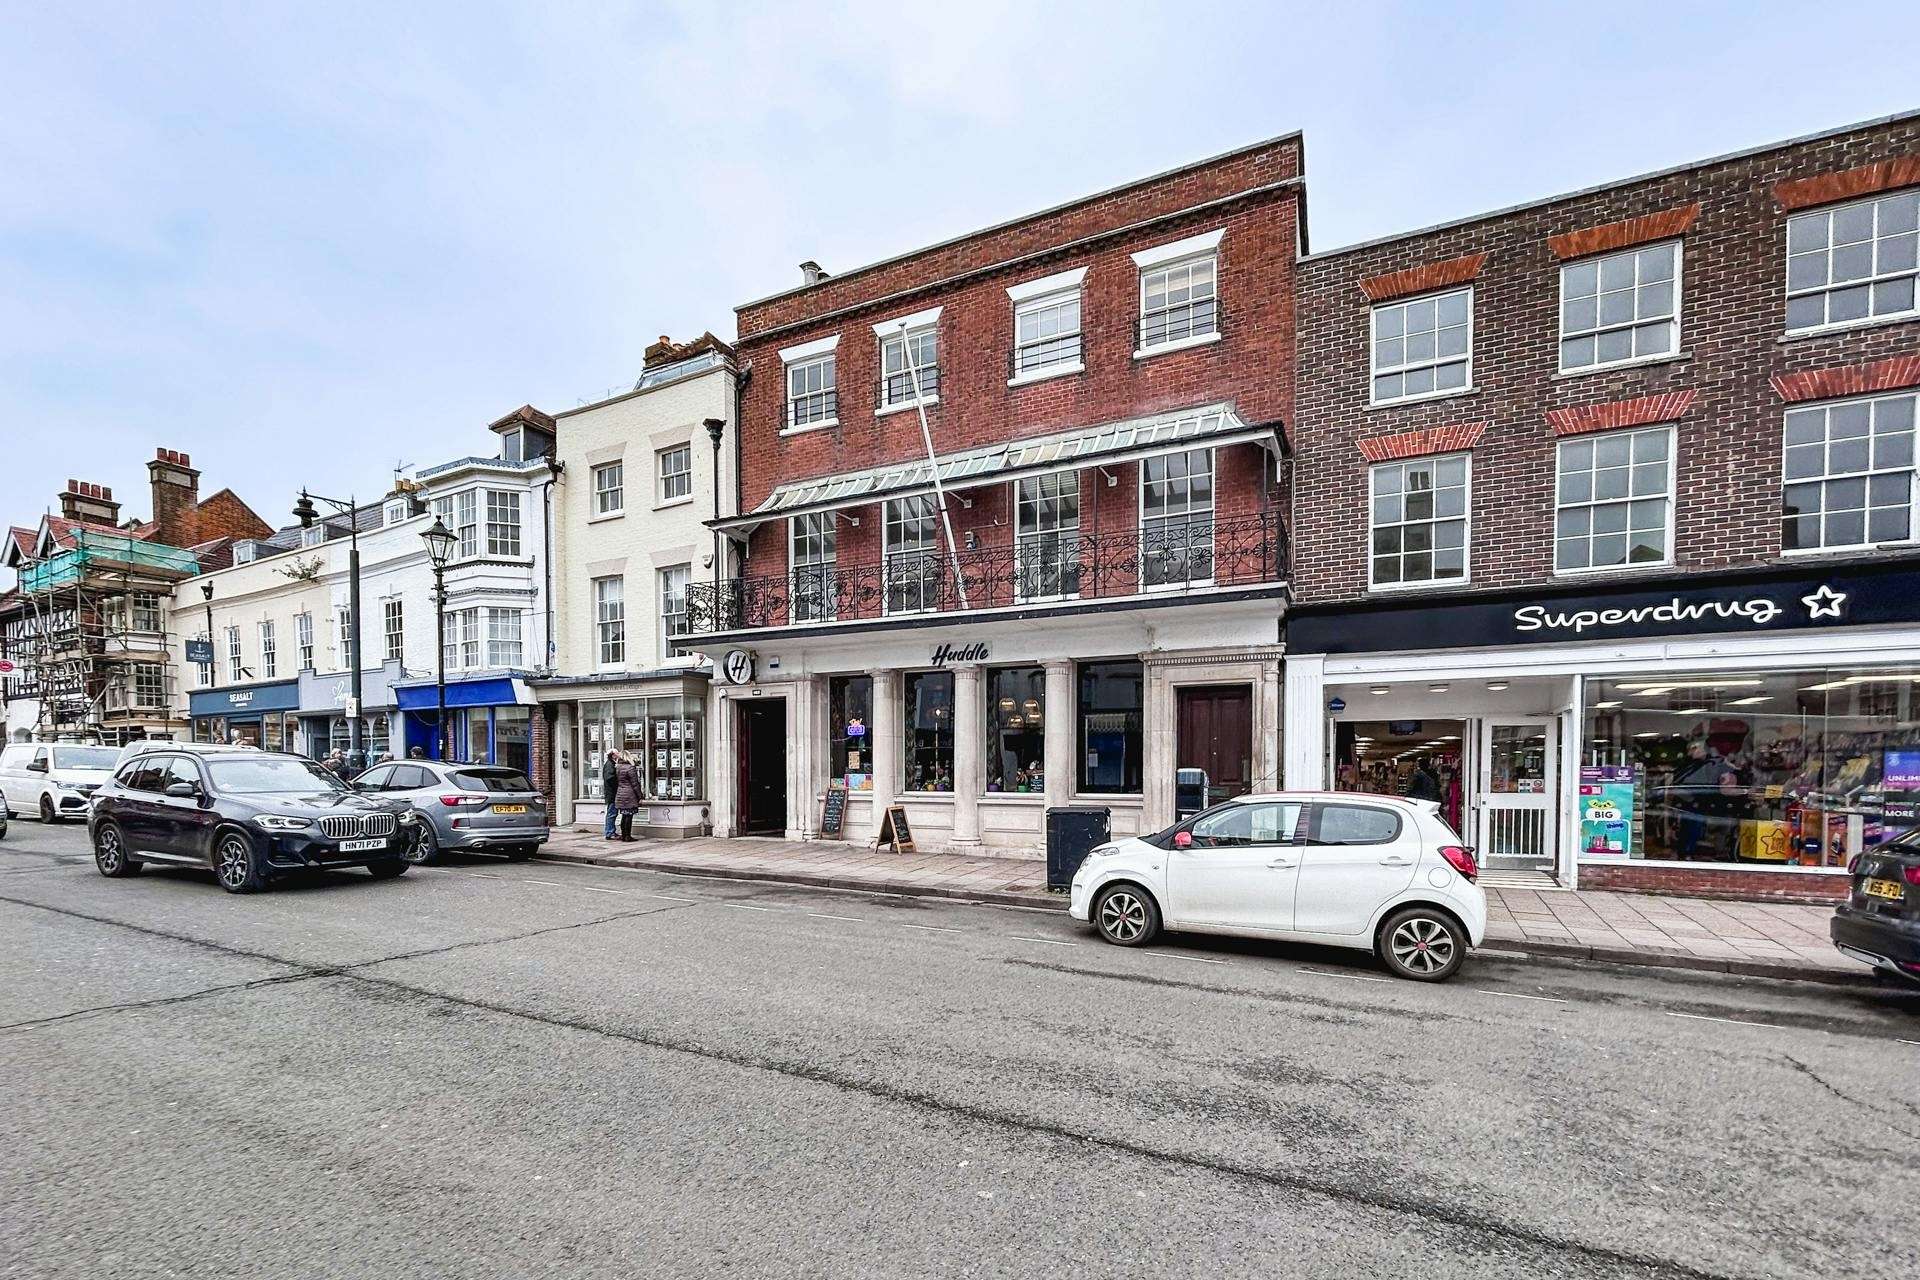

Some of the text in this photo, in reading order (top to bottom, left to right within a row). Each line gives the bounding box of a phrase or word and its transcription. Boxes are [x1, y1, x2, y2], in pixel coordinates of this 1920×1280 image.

[1514, 598, 1782, 632] Superdrug
[931, 642, 989, 668] Huddle
[229, 691, 254, 703] SEASALT
[1885, 810, 1915, 818] MORE
[345, 840, 382, 850] HN71 PZP
